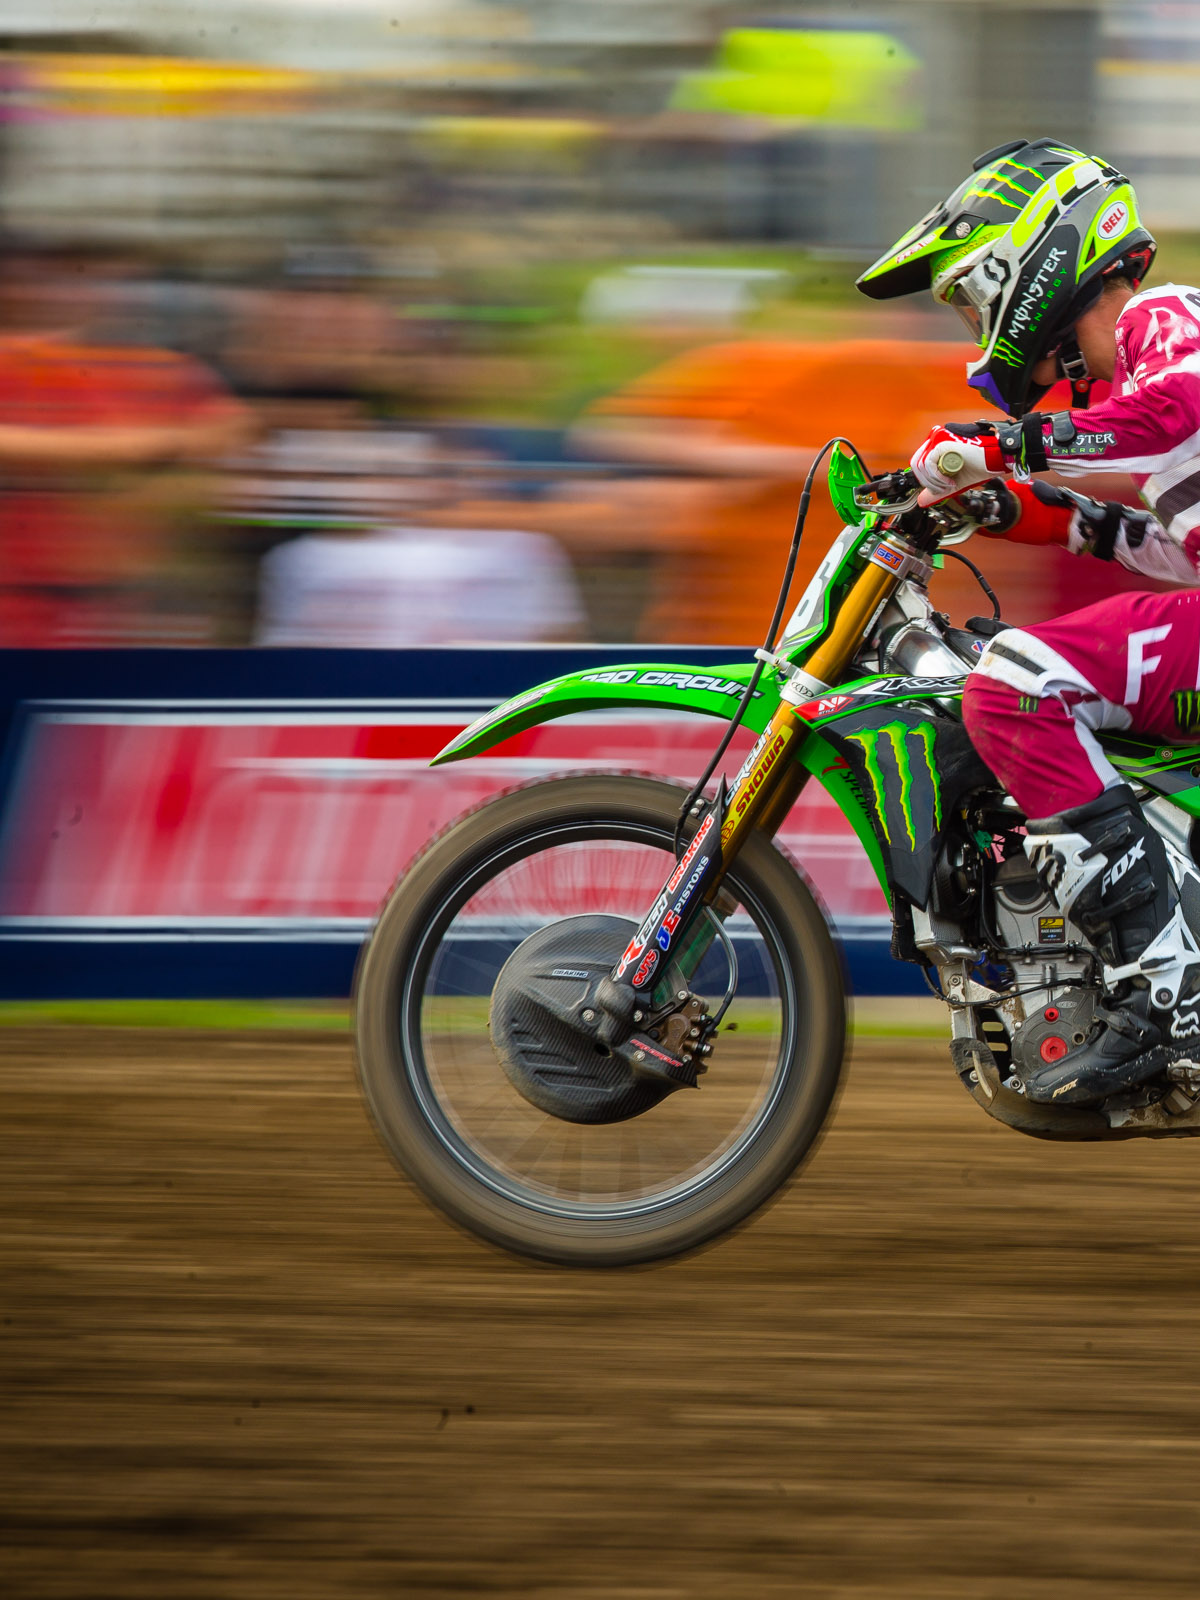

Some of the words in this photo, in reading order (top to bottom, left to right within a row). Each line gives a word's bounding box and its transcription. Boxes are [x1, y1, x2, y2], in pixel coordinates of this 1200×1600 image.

[1101, 207, 1125, 234] BELL
[1028, 267, 1067, 332] ENERGY
[1043, 432, 1115, 447] MSTER
[1052, 447, 1105, 455] ENERGY
[876, 548, 901, 566] GET
[638, 671, 766, 699] CIRCUIT
[882, 675, 964, 692] KX
[725, 719, 774, 807] CIRCUIT
[735, 734, 785, 817] SHOWA
[667, 813, 715, 893] BRAKING
[1101, 836, 1146, 897] FOX
[674, 856, 709, 913] PISTONS
[656, 909, 681, 952] JE
[632, 949, 657, 986] GUTS
[1052, 1078, 1079, 1099] FOX
